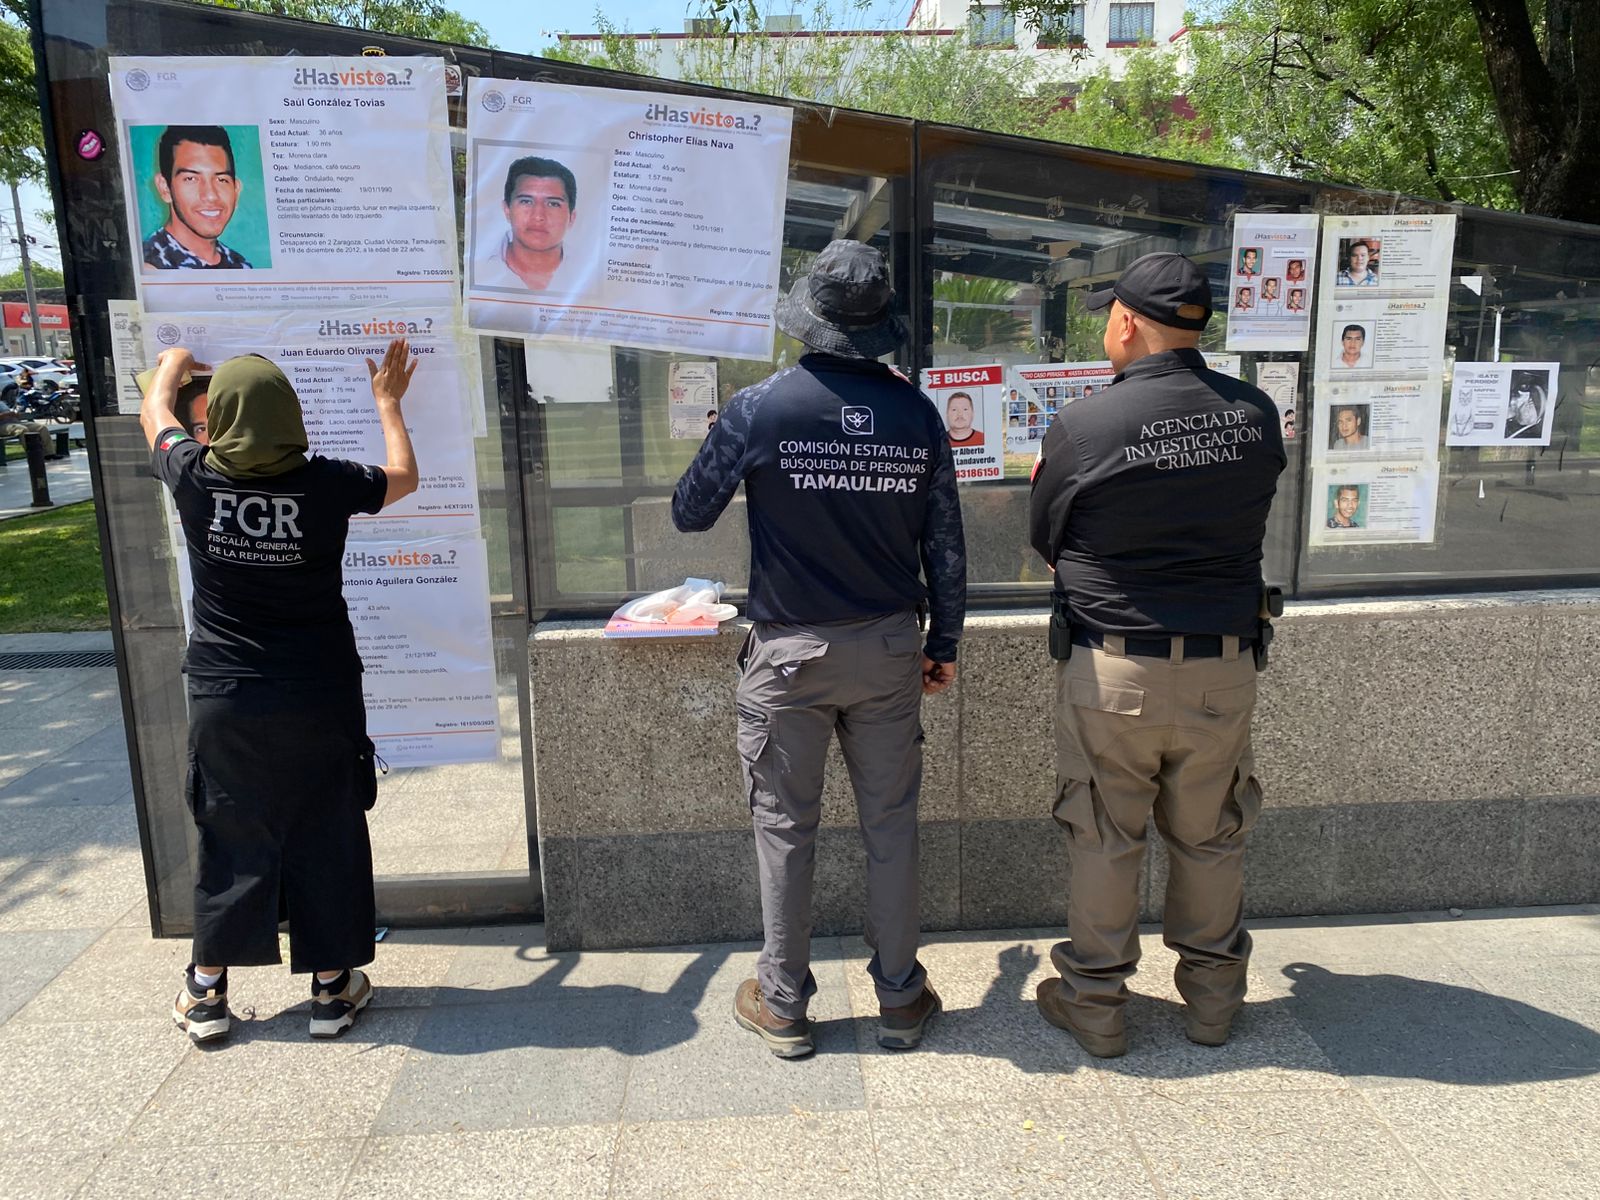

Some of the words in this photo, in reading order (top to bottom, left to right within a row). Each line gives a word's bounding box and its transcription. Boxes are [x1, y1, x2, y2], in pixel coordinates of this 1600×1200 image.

[156, 72, 177, 81] FGR
[283, 98, 305, 107] Saúl
[307, 98, 352, 107] González
[354, 98, 386, 107] Tovias
[512, 95, 532, 105] FGR
[628, 130, 684, 144] Christopher
[685, 135, 708, 147] Elías
[710, 139, 734, 150] Nava
[635, 150, 665, 159] Masculino
[614, 160, 631, 168] Edad
[670, 164, 686, 173] años
[629, 183, 652, 191] Morena
[652, 185, 667, 193] clara
[655, 196, 669, 205] café
[669, 198, 684, 206] claro
[408, 204, 436, 212] izquierda
[659, 209, 683, 218] castaño
[683, 212, 704, 220] oscuro
[611, 216, 630, 224] Fecha
[630, 217, 639, 225] de
[610, 225, 629, 234] Señas
[280, 239, 318, 247] Desapareció
[609, 233, 631, 242] Cicatriz
[640, 236, 660, 245] pierna
[660, 238, 687, 248] izquierda
[693, 241, 728, 252] deformación
[737, 246, 753, 254] dedo
[617, 242, 635, 250] mano
[635, 243, 659, 252] derecha
[607, 266, 619, 274] Fue
[620, 268, 655, 278] secuestrado
[752, 282, 765, 290] julio
[636, 277, 652, 285] edad
[186, 326, 207, 335] FGR
[280, 349, 304, 357] Juan
[306, 347, 345, 357] Eduardo
[347, 346, 386, 356] Olivares
[944, 371, 990, 385] BUSCA
[1139, 413, 1222, 440] AGENCIA
[1223, 409, 1248, 426] DE
[778, 439, 851, 456] COMISIÓN
[854, 443, 911, 459] ESTATAL
[912, 447, 929, 460] DE
[1123, 426, 1263, 462] INVESTIGACIÓN
[959, 447, 985, 456] Alberto
[956, 456, 996, 466] Landaverde
[1155, 445, 1243, 470] CRIMINAL
[780, 455, 848, 471] BÚSQUEDA
[850, 460, 867, 472] DE
[869, 462, 926, 474] PERSONAS
[789, 473, 918, 494] TAMAULIPAS
[209, 492, 303, 539] FGR
[207, 533, 251, 548] FISCALÍA
[255, 541, 302, 551] GENERAL
[208, 544, 221, 555] DE
[223, 549, 237, 558] LA
[239, 551, 302, 562] REPÚBLICA
[375, 577, 414, 587] Aguilera
[416, 575, 458, 585] González
